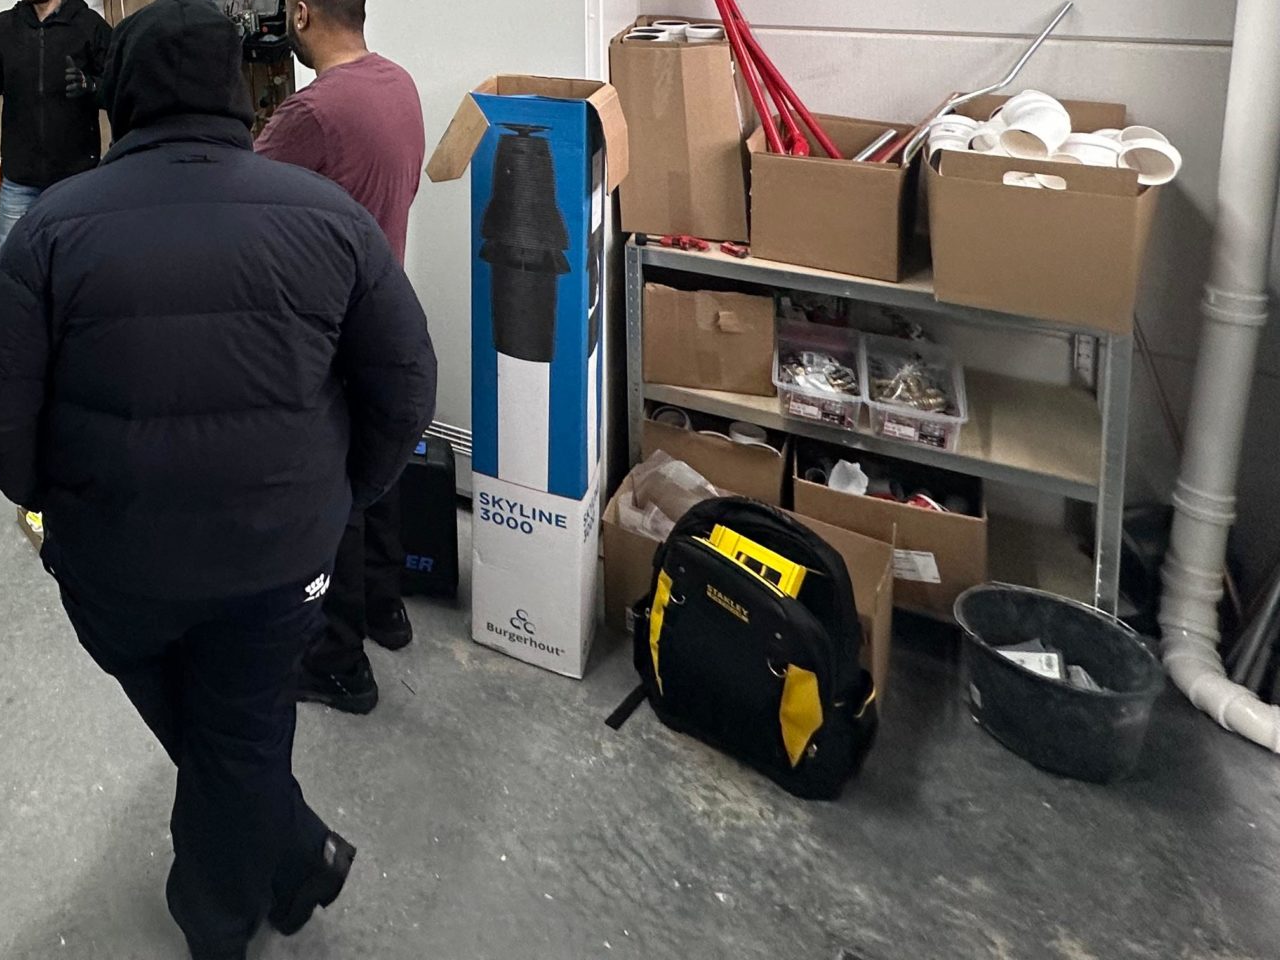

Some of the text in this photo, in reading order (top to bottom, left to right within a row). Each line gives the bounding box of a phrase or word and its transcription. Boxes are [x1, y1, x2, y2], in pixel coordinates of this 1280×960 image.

[479, 492, 568, 529] SKYLINE
[480, 507, 533, 535] 3000
[706, 583, 749, 615] STANLEY
[486, 622, 561, 657] Burgerhout
